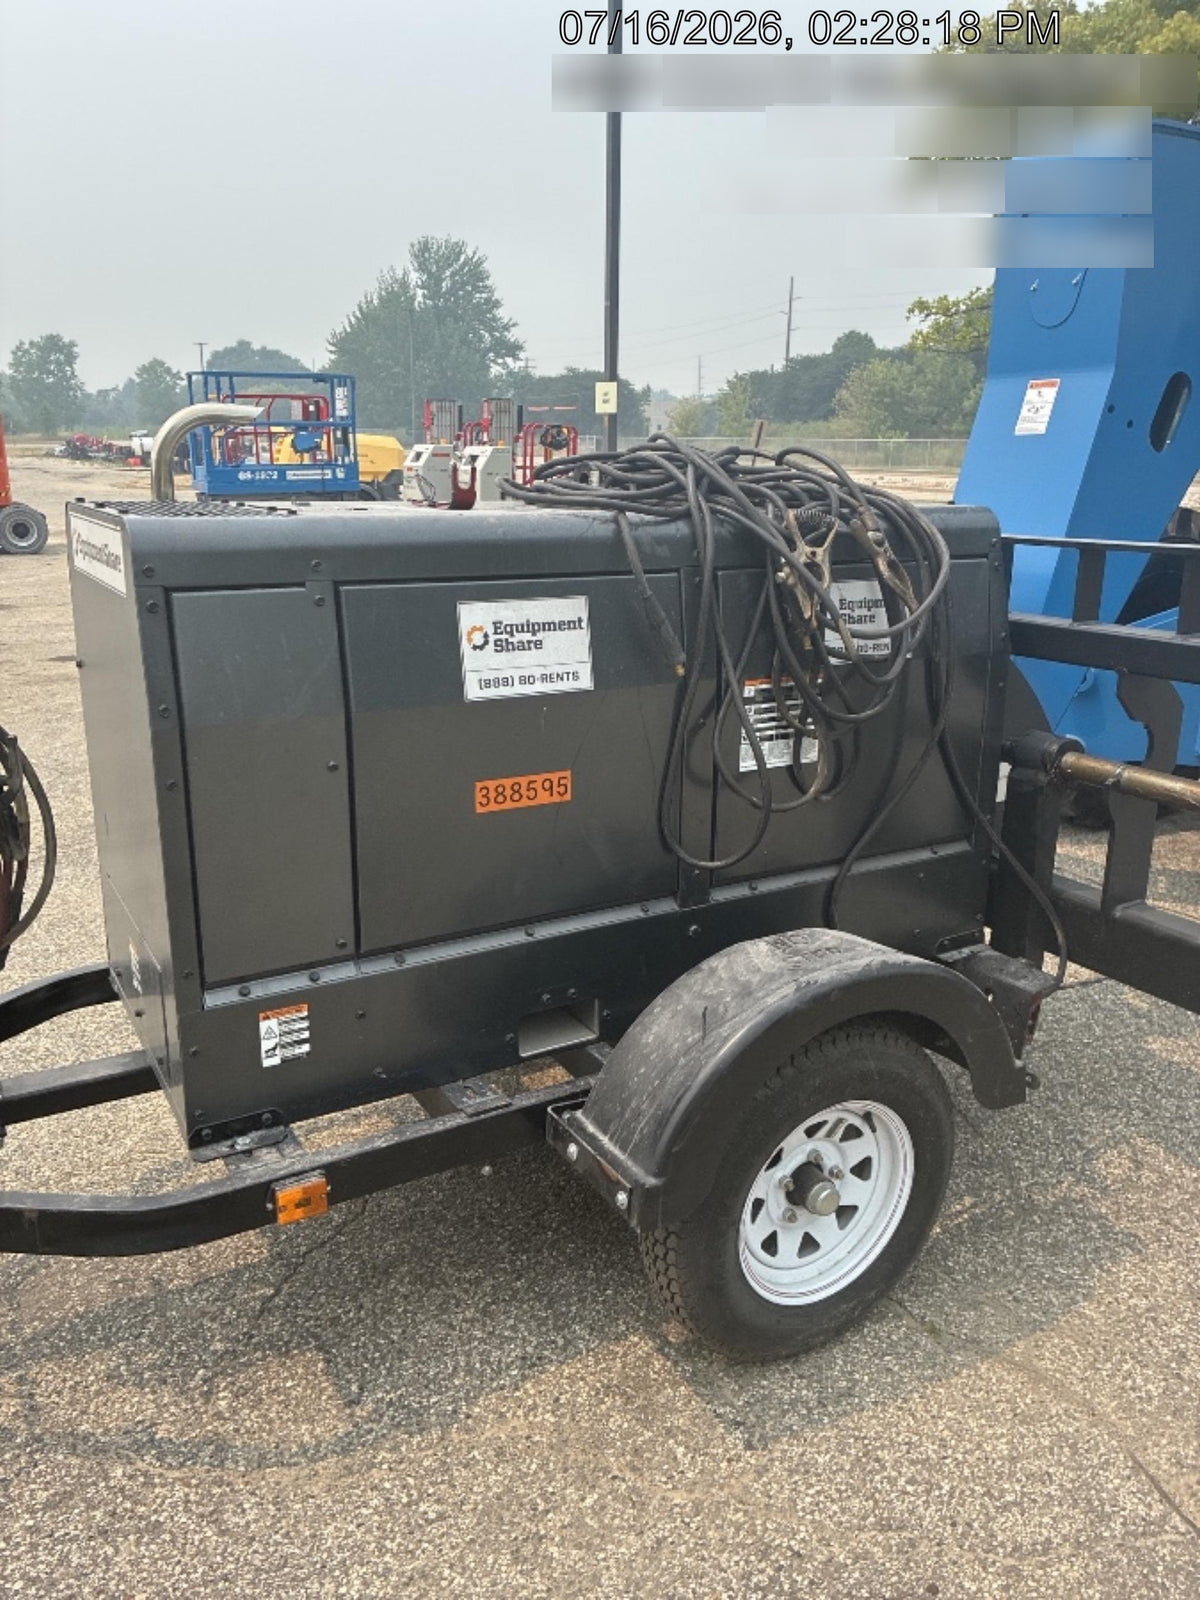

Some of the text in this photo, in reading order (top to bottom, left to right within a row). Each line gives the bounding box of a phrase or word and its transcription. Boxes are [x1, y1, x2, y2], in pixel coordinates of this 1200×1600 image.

[492, 616, 584, 637] Equipment
[493, 638, 543, 653] Share
[518, 671, 580, 685] 80-RENTS
[478, 776, 569, 808] 388595
